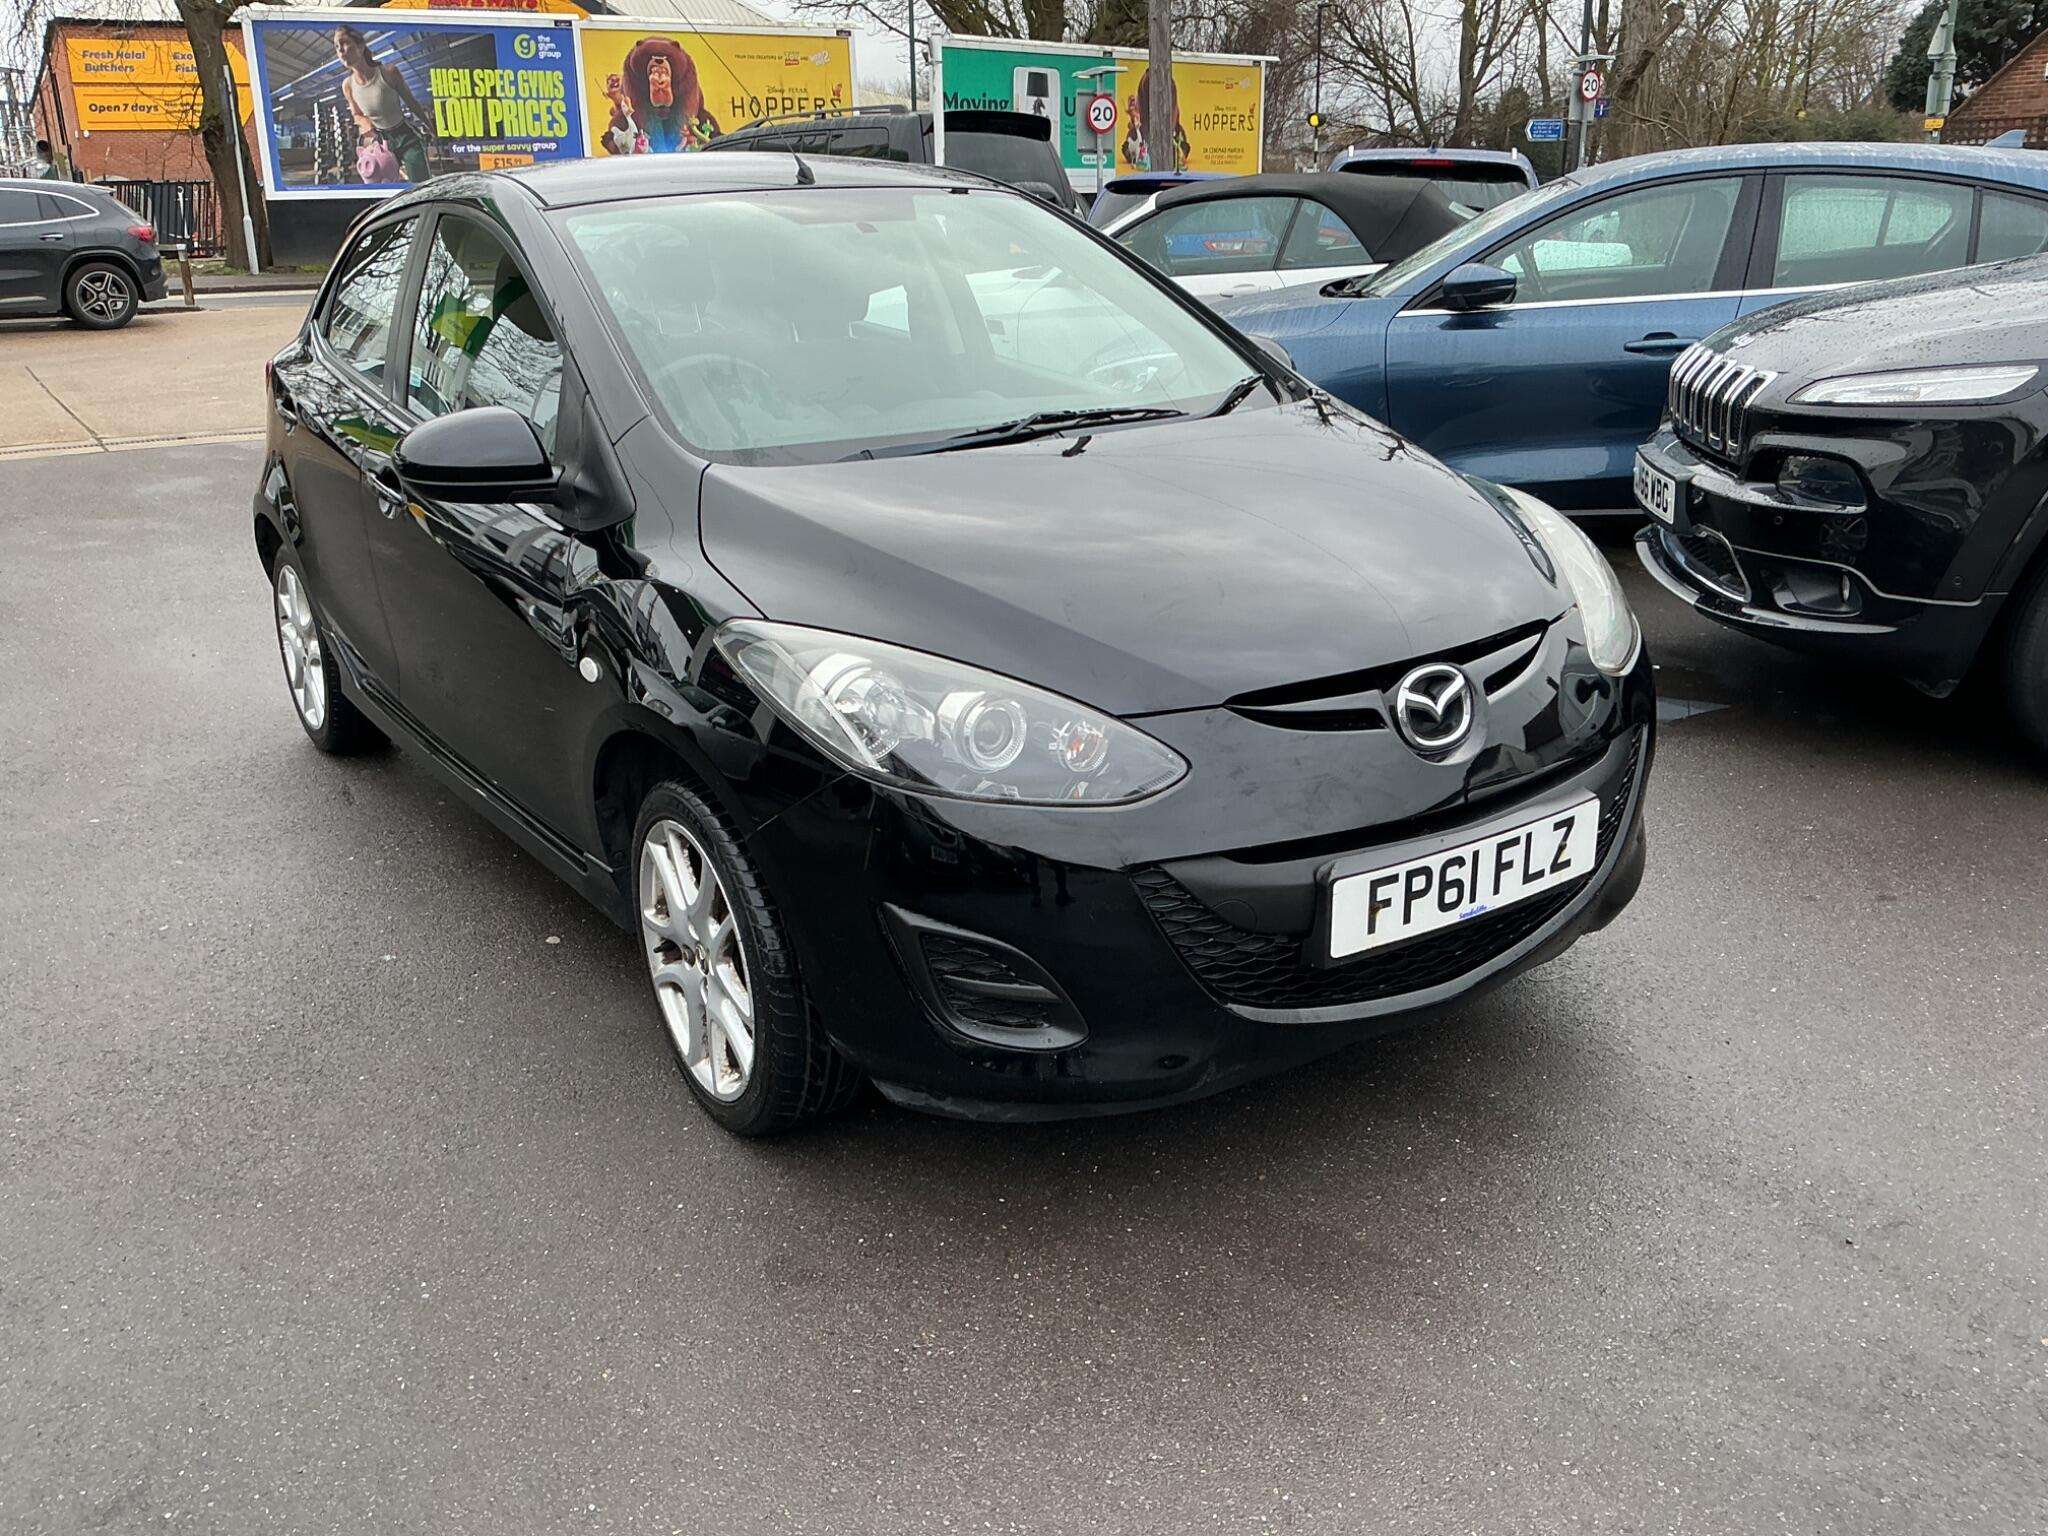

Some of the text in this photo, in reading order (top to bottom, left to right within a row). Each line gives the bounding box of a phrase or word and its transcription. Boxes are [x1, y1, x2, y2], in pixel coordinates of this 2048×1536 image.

[537, 34, 551, 43] the
[82, 50, 146, 60] Fresh Halal
[538, 51, 562, 59] group
[84, 63, 135, 73] Butchers
[430, 68, 565, 99] HIGH SPEC GYMS
[1584, 79, 1598, 92] 20
[88, 103, 121, 114] Open
[122, 103, 129, 112] 7
[131, 102, 159, 114] days
[731, 95, 843, 118] HOPPERS
[433, 98, 568, 138] LOW PRICES
[1092, 106, 1113, 122] 20
[1193, 113, 1255, 132] HOPPERS
[452, 142, 558, 153] for the super savvy group
[1367, 815, 1576, 936] FP61 FLZ
